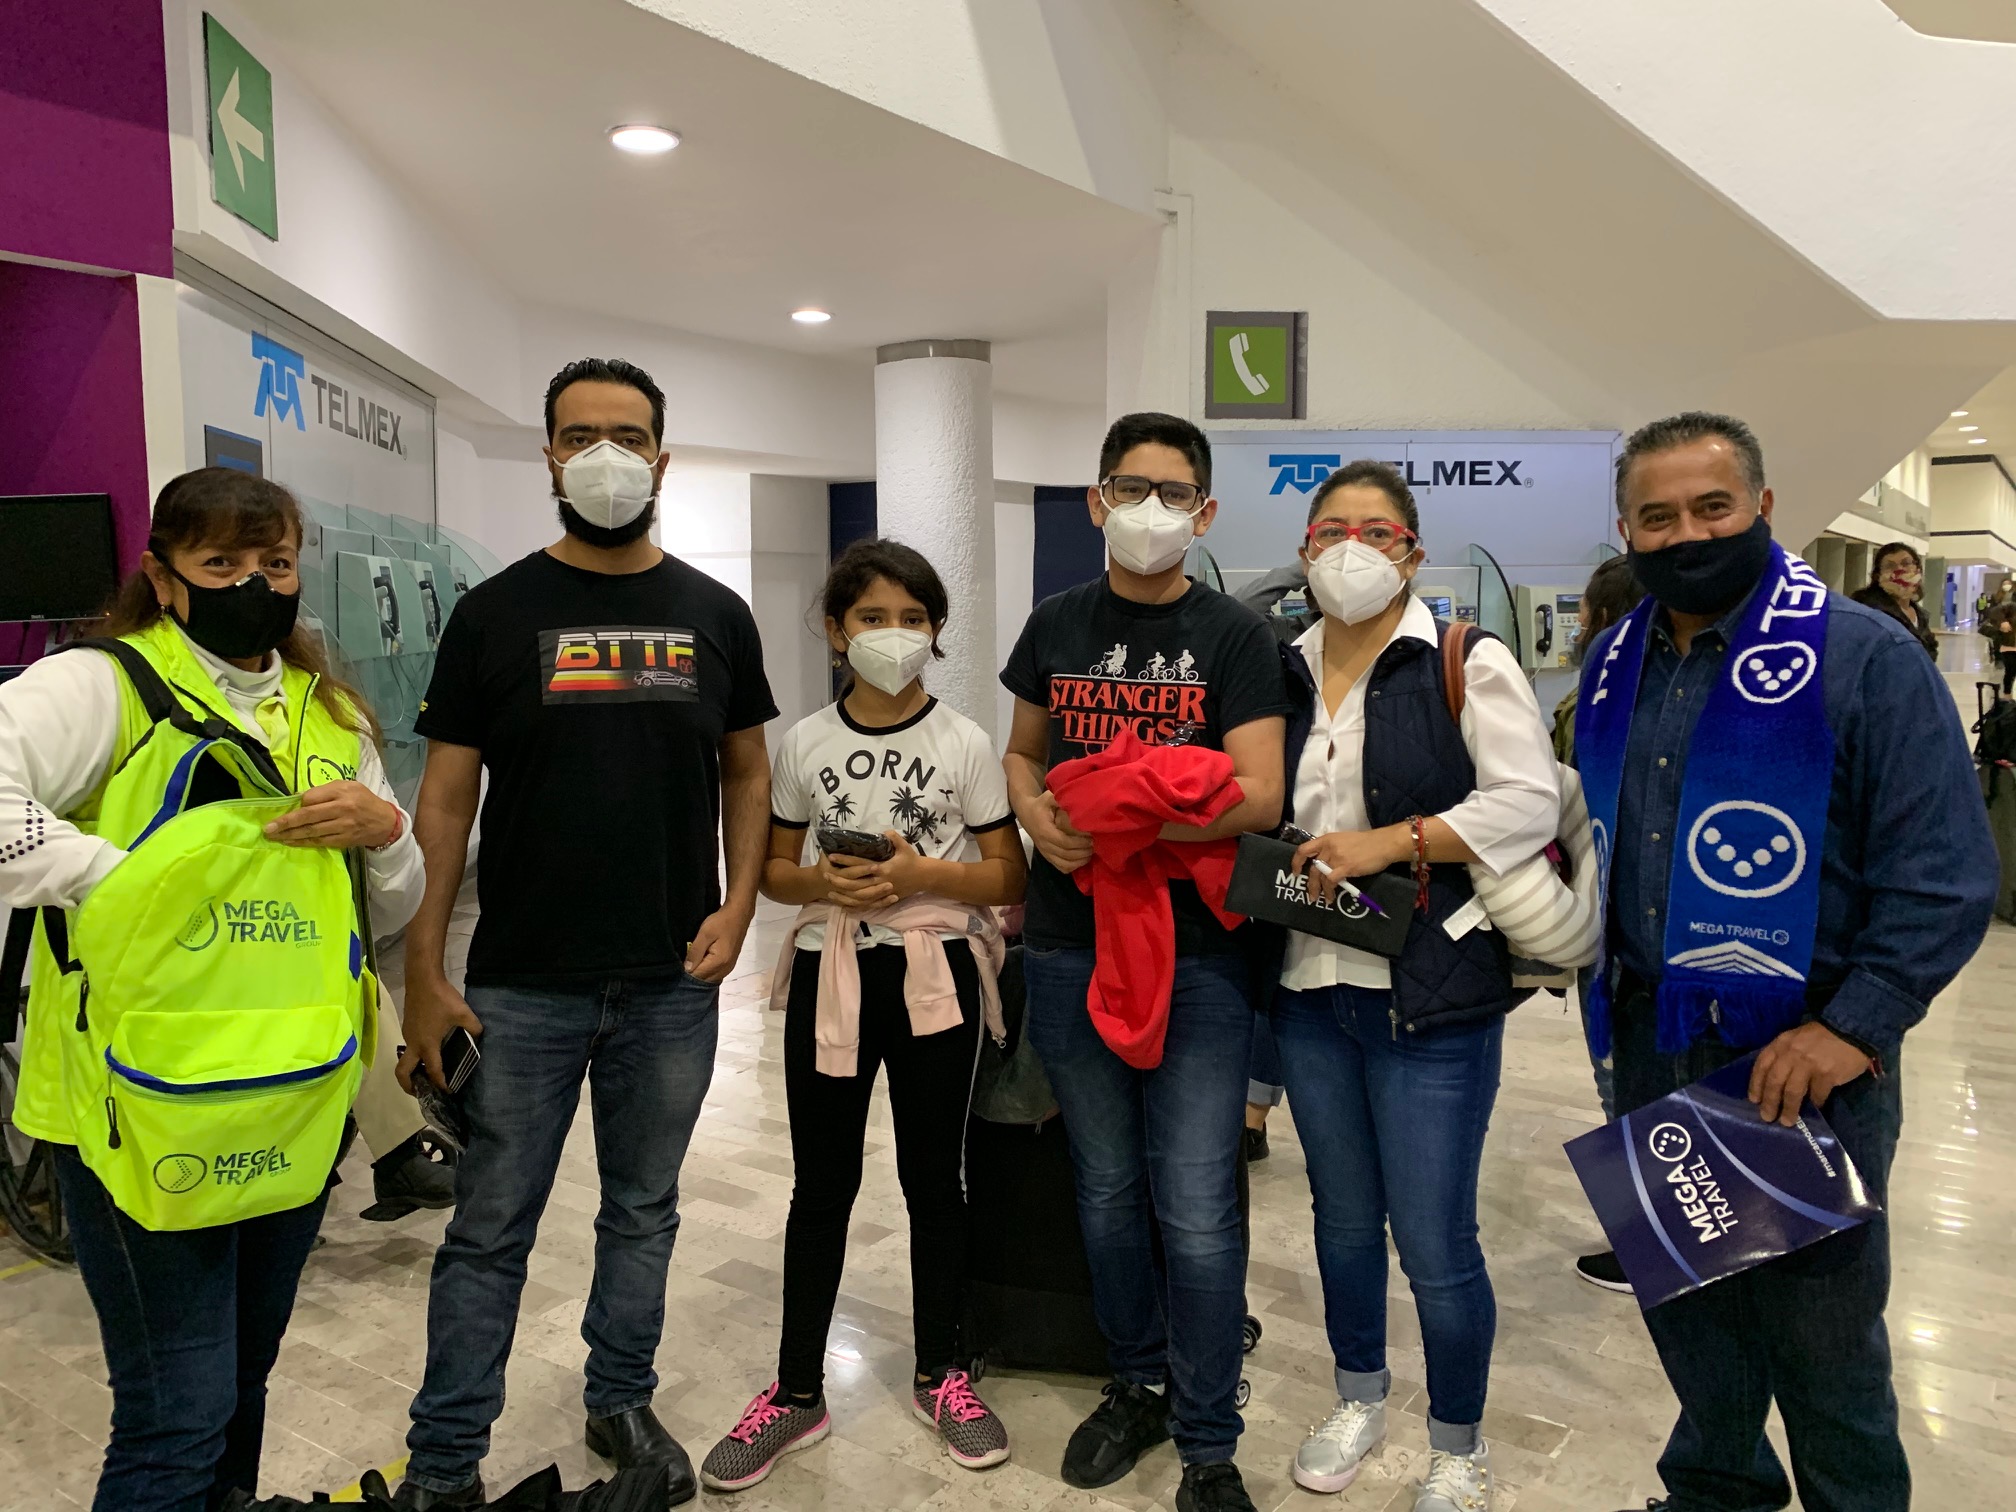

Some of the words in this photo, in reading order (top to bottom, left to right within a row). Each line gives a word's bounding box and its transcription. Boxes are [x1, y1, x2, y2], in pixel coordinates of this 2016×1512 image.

[311, 373, 402, 455] TELMEX
[1380, 460, 1522, 486] LMEX
[555, 631, 694, 669] BTTF
[1050, 678, 1207, 723] STRANGER
[1061, 710, 1178, 744] THINGS
[819, 749, 936, 795] BORN
[1275, 869, 1309, 891] ME
[223, 900, 300, 921] MEGA
[227, 920, 323, 943] TRAVEL
[1689, 921, 1724, 935] MEGA
[1726, 924, 1771, 941] TRAVEL
[213, 1151, 292, 1186] TRAVEL
[214, 1145, 277, 1170] MEGA
[1666, 1163, 1722, 1243] MEGA
[1689, 1154, 1739, 1234] TRAVEL
